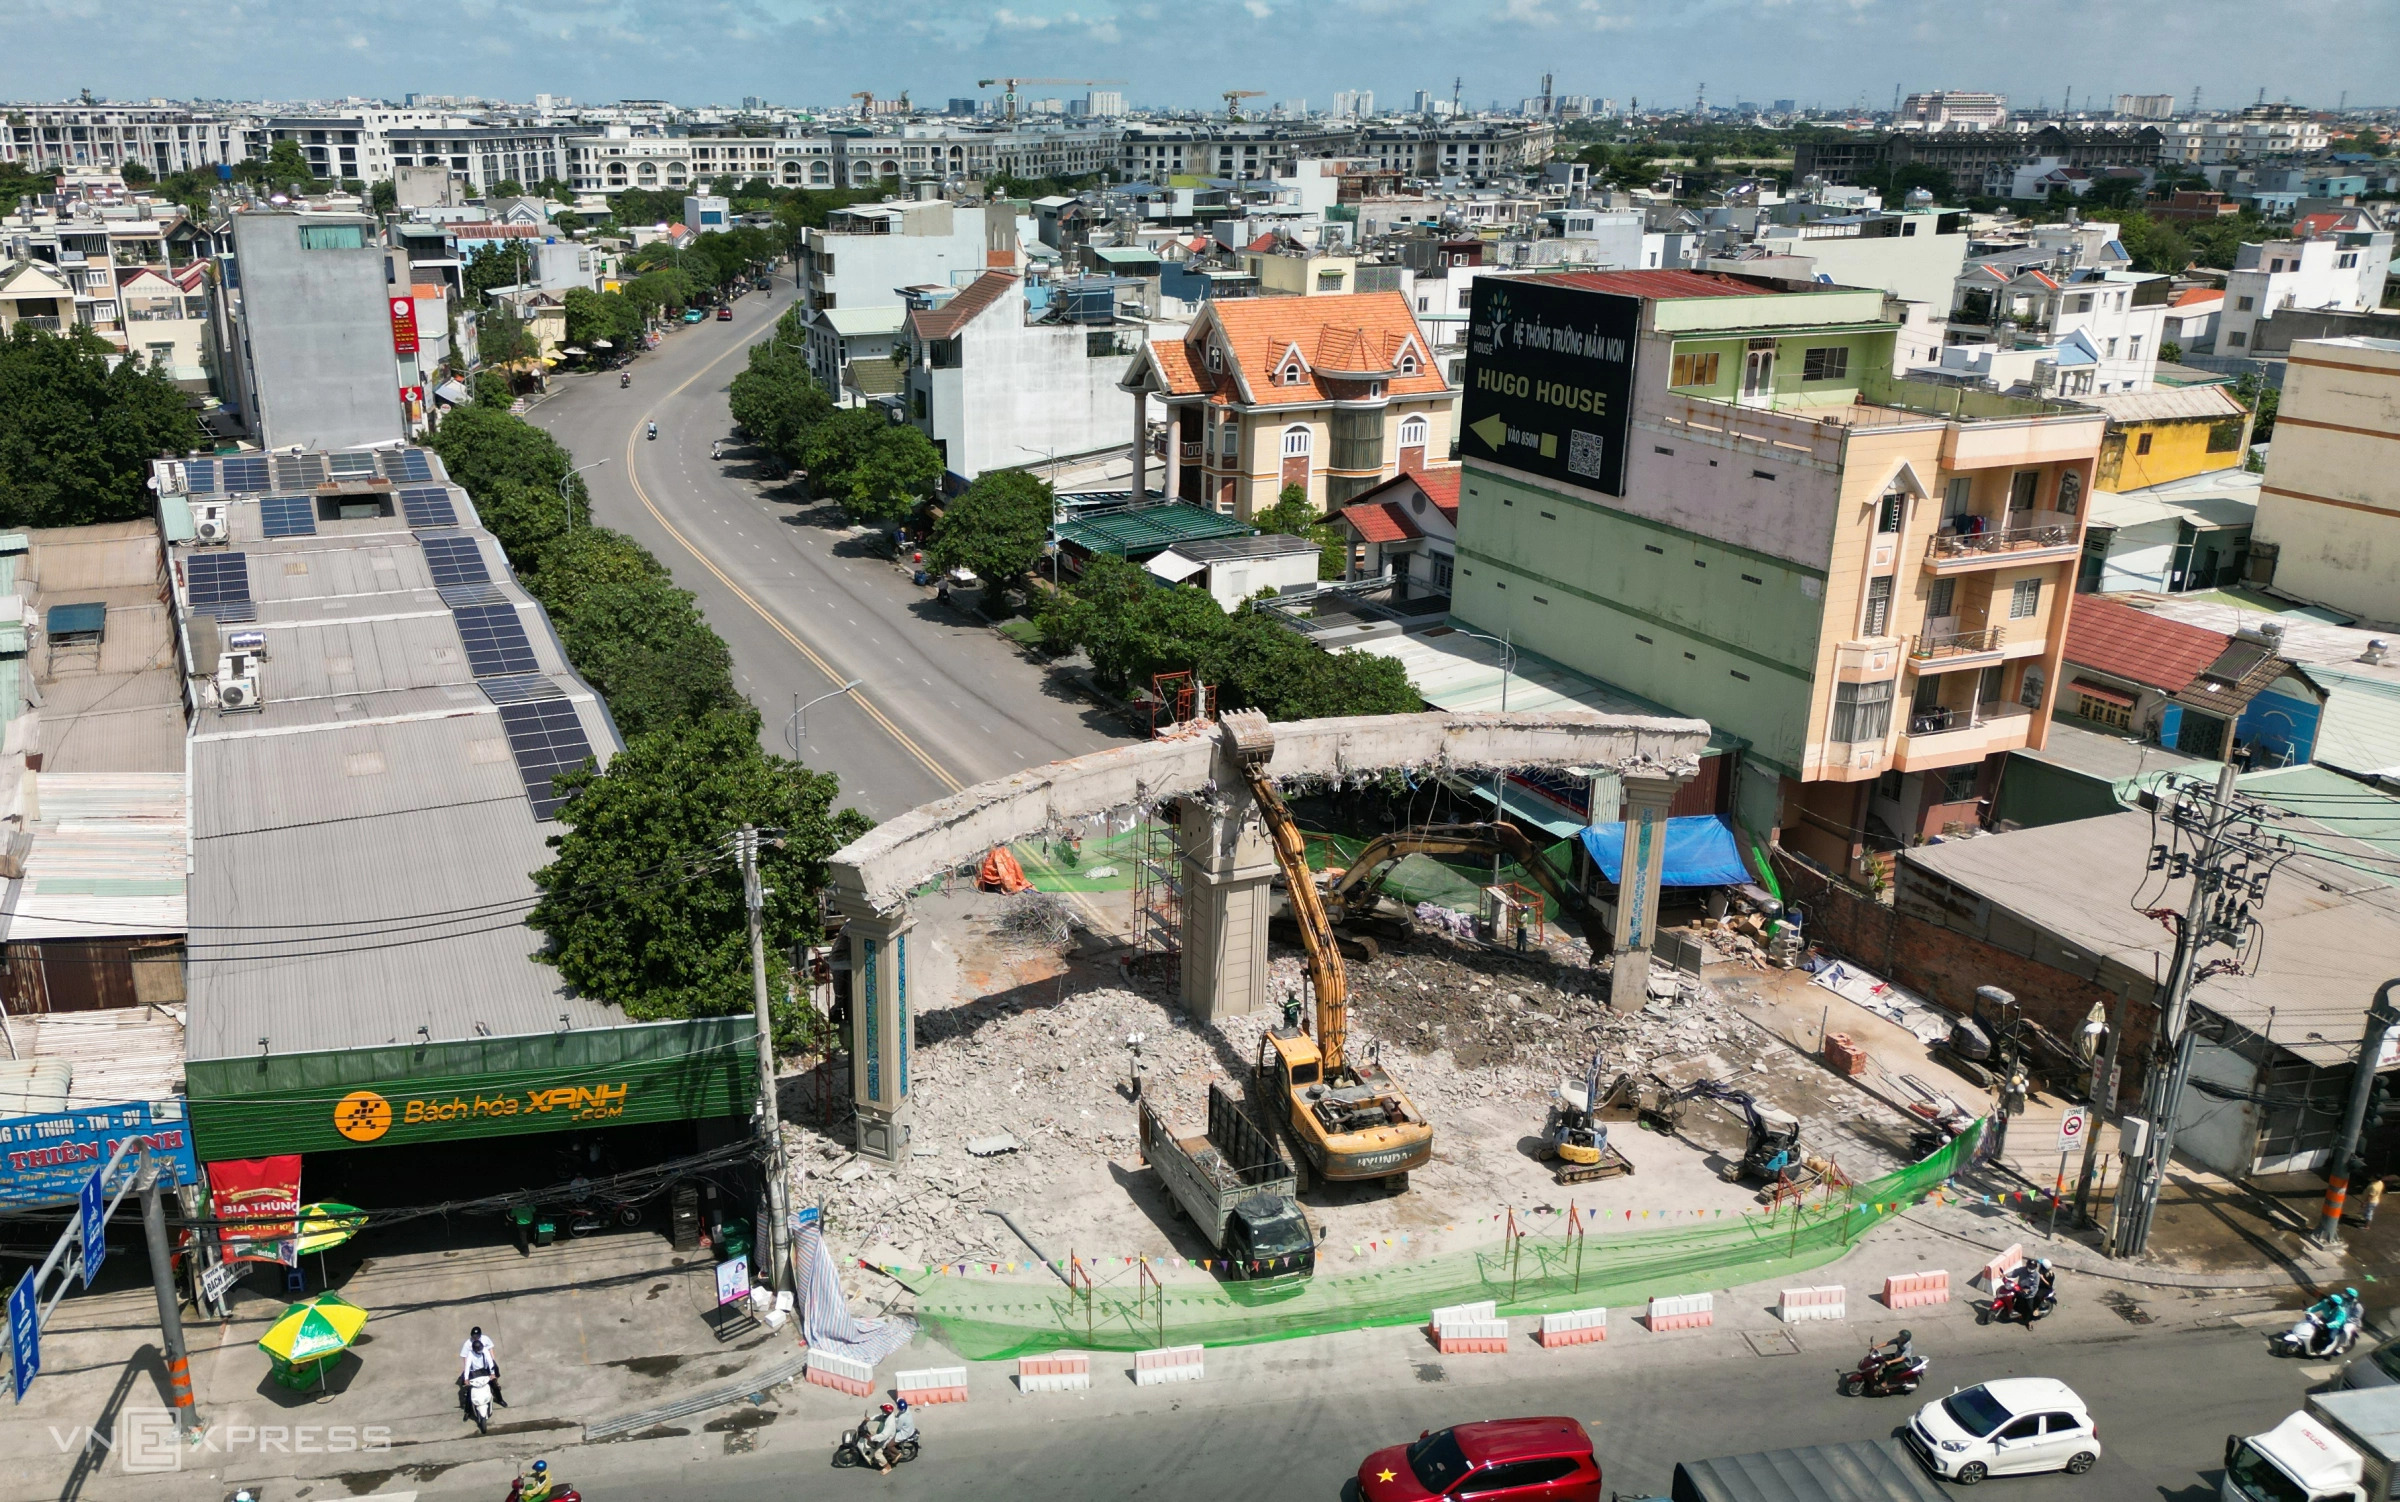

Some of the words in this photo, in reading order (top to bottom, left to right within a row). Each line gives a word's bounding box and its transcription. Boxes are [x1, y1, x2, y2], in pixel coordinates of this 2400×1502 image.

[1475, 323, 1491, 338] HUGO
[1513, 317, 1525, 350] HỆ
[1526, 313, 1550, 350] THỐNG
[1552, 324, 1583, 355] TRƯỜNG
[1605, 338, 1625, 363] NON
[1473, 341, 1493, 356] HOUSE
[1477, 367, 1529, 398] HUGO
[1535, 379, 1608, 416] HOUSE
[1507, 425, 1521, 443] VÀO
[403, 1096, 468, 1124] Bách
[472, 1093, 519, 1118] hóa
[523, 1083, 628, 1114] XANH
[15, 1124, 33, 1142] TY
[35, 1118, 75, 1139] TNHH
[87, 1114, 110, 1132] TM
[122, 1109, 140, 1127] DV
[8, 1140, 99, 1171] THIÊN
[223, 1204, 248, 1214] BIA
[2300, 1428, 2329, 1451] ISUZU
